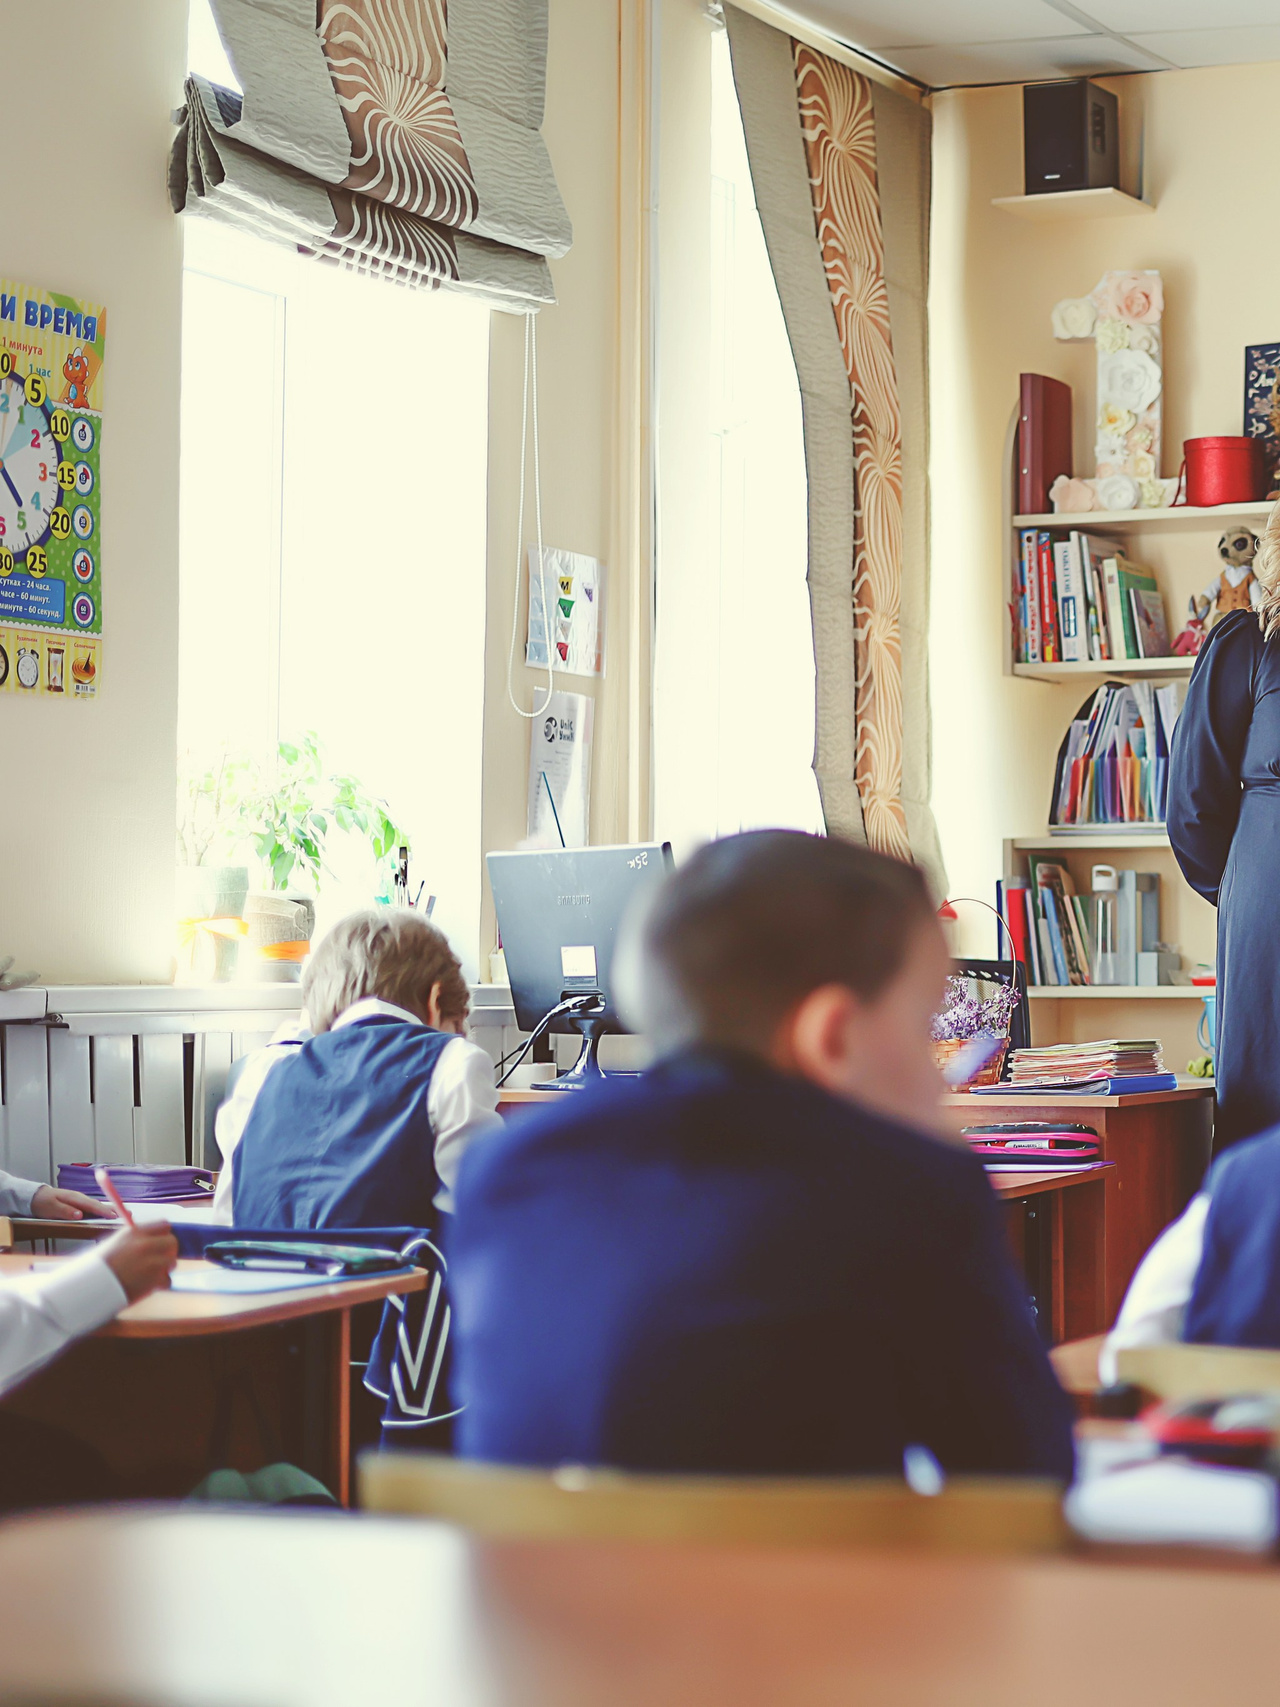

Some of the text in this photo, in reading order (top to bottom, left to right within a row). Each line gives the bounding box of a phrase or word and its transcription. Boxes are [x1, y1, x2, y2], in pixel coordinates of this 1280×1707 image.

[1, 293, 97, 342] И ВРЕМЯ
[2, 336, 43, 356] 1 минута
[36, 367, 51, 378] час
[30, 378, 41, 403] 5
[18, 405, 25, 423] 1
[52, 415, 69, 436] 10
[31, 429, 41, 448] 2
[39, 462, 47, 482] 3
[59, 467, 75, 485] 15
[31, 491, 41, 511] 4
[17, 511, 27, 530] 5
[51, 511, 70, 533] 20
[29, 551, 47, 573] 25
[26, 580, 35, 589] 24
[20, 592, 29, 600] 60
[28, 605, 37, 614] 60
